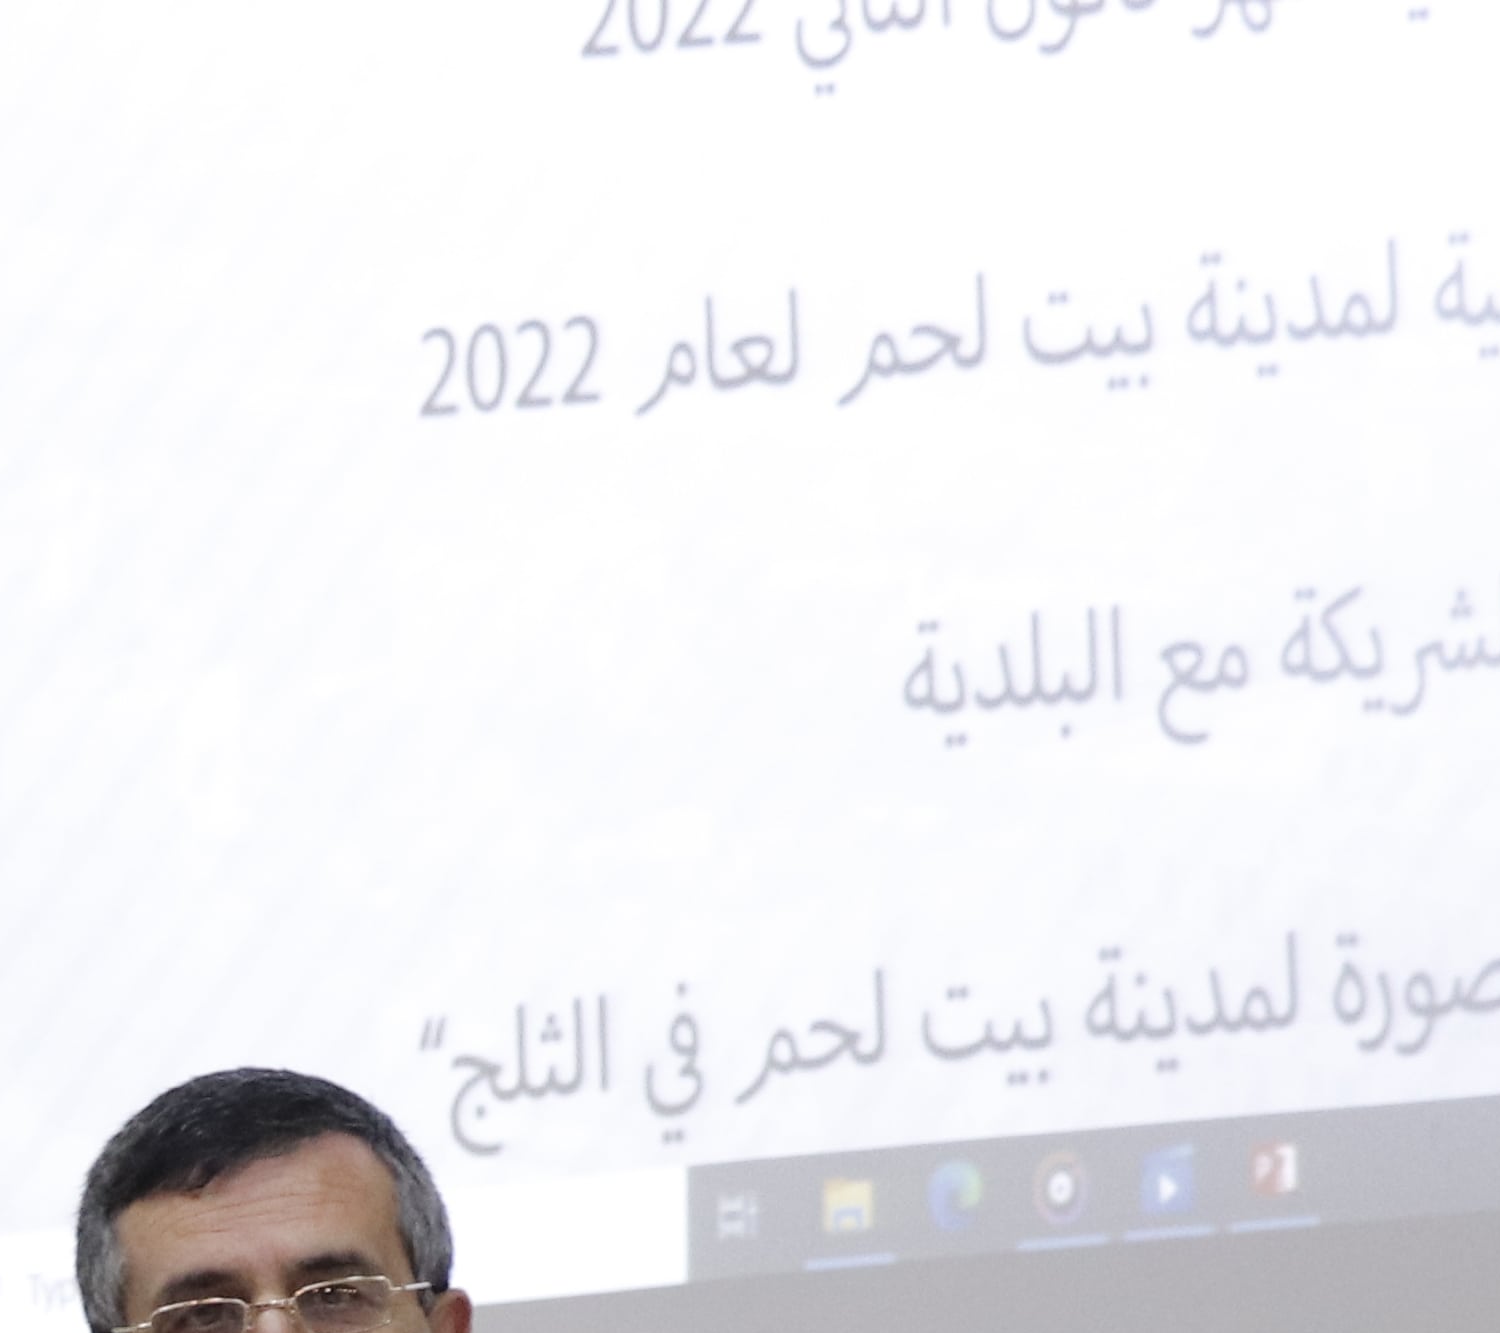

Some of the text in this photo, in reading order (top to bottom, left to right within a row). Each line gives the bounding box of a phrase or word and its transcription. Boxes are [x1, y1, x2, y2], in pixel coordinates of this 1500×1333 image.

[419, 314, 602, 419] 2022
[634, 287, 801, 417] لعام
[836, 272, 988, 408] لحم
[1022, 291, 1155, 391] بيت
[1186, 239, 1399, 378] لمدينة
[902, 604, 1124, 749] البلدية
[1157, 640, 1250, 747] مع
[643, 982, 705, 1145] في
[734, 967, 888, 1106] لحم
[920, 985, 1055, 1087] بيت
[1084, 931, 1300, 1074] لمدينة
